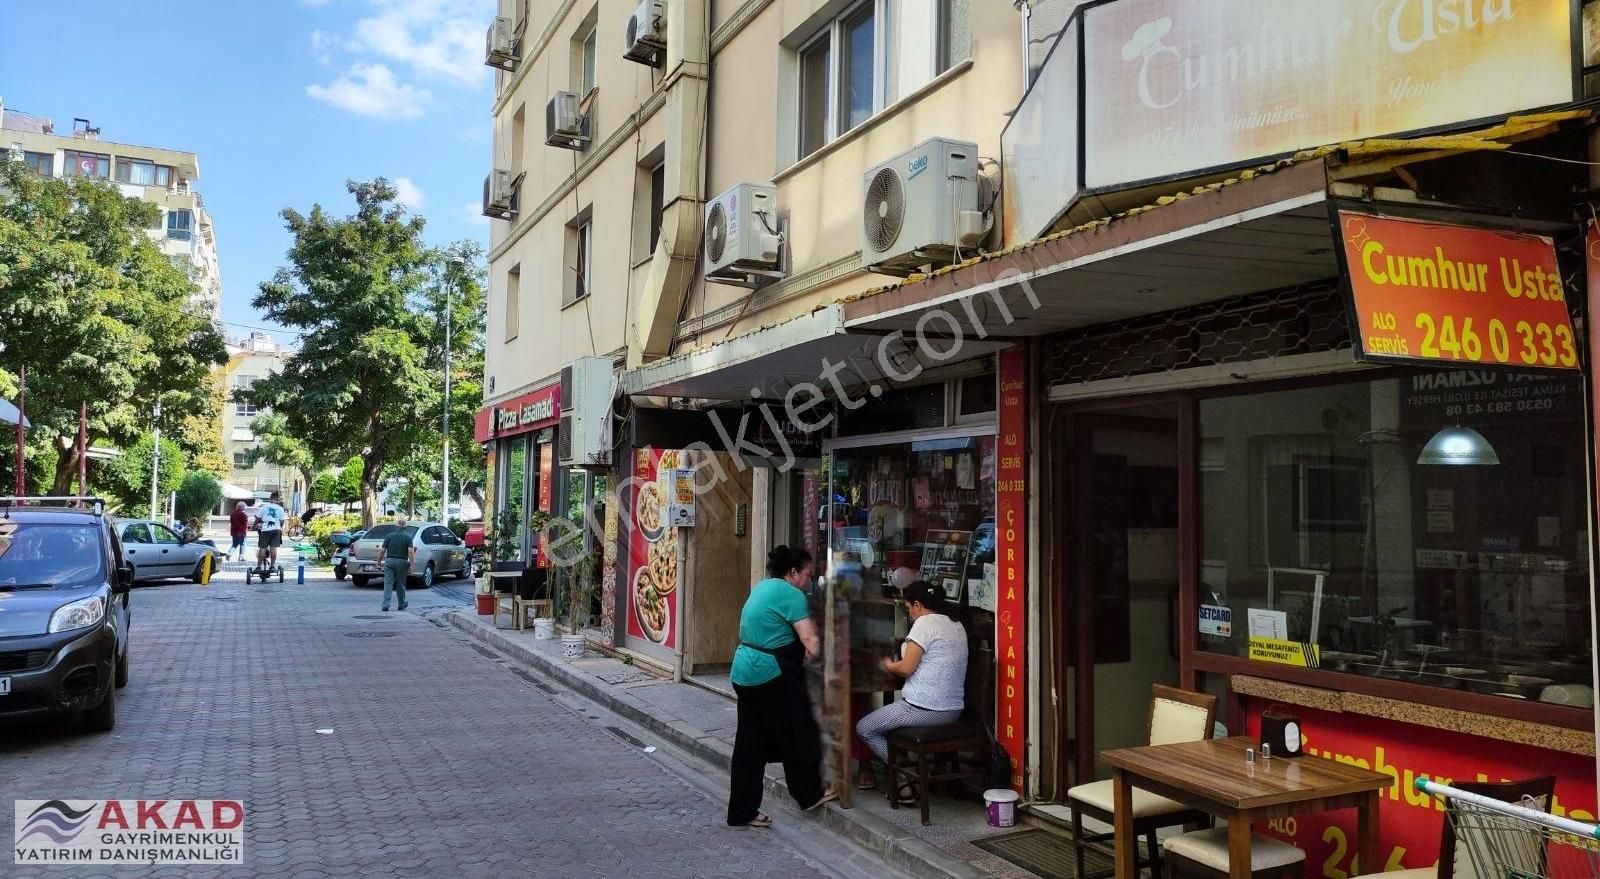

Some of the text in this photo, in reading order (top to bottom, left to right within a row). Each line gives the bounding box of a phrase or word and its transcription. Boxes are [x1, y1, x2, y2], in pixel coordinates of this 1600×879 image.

[1138, 0, 1516, 109] Cumhur Usta
[908, 154, 929, 173] beko
[1362, 240, 1563, 301] Cumhur Usta
[1372, 311, 1396, 331] ALO
[1368, 312, 1578, 367] SERVİS 246 0 333
[498, 408, 517, 430] Pizza
[1004, 433, 1017, 446] ALO
[998, 480, 1008, 492] 246
[1013, 480, 1025, 492] 333
[1006, 510, 1015, 600] ÇORBA
[1199, 606, 1231, 623] SETCARD
[1006, 626, 1015, 738] TANDIR
[1268, 817, 1297, 836] ALO
